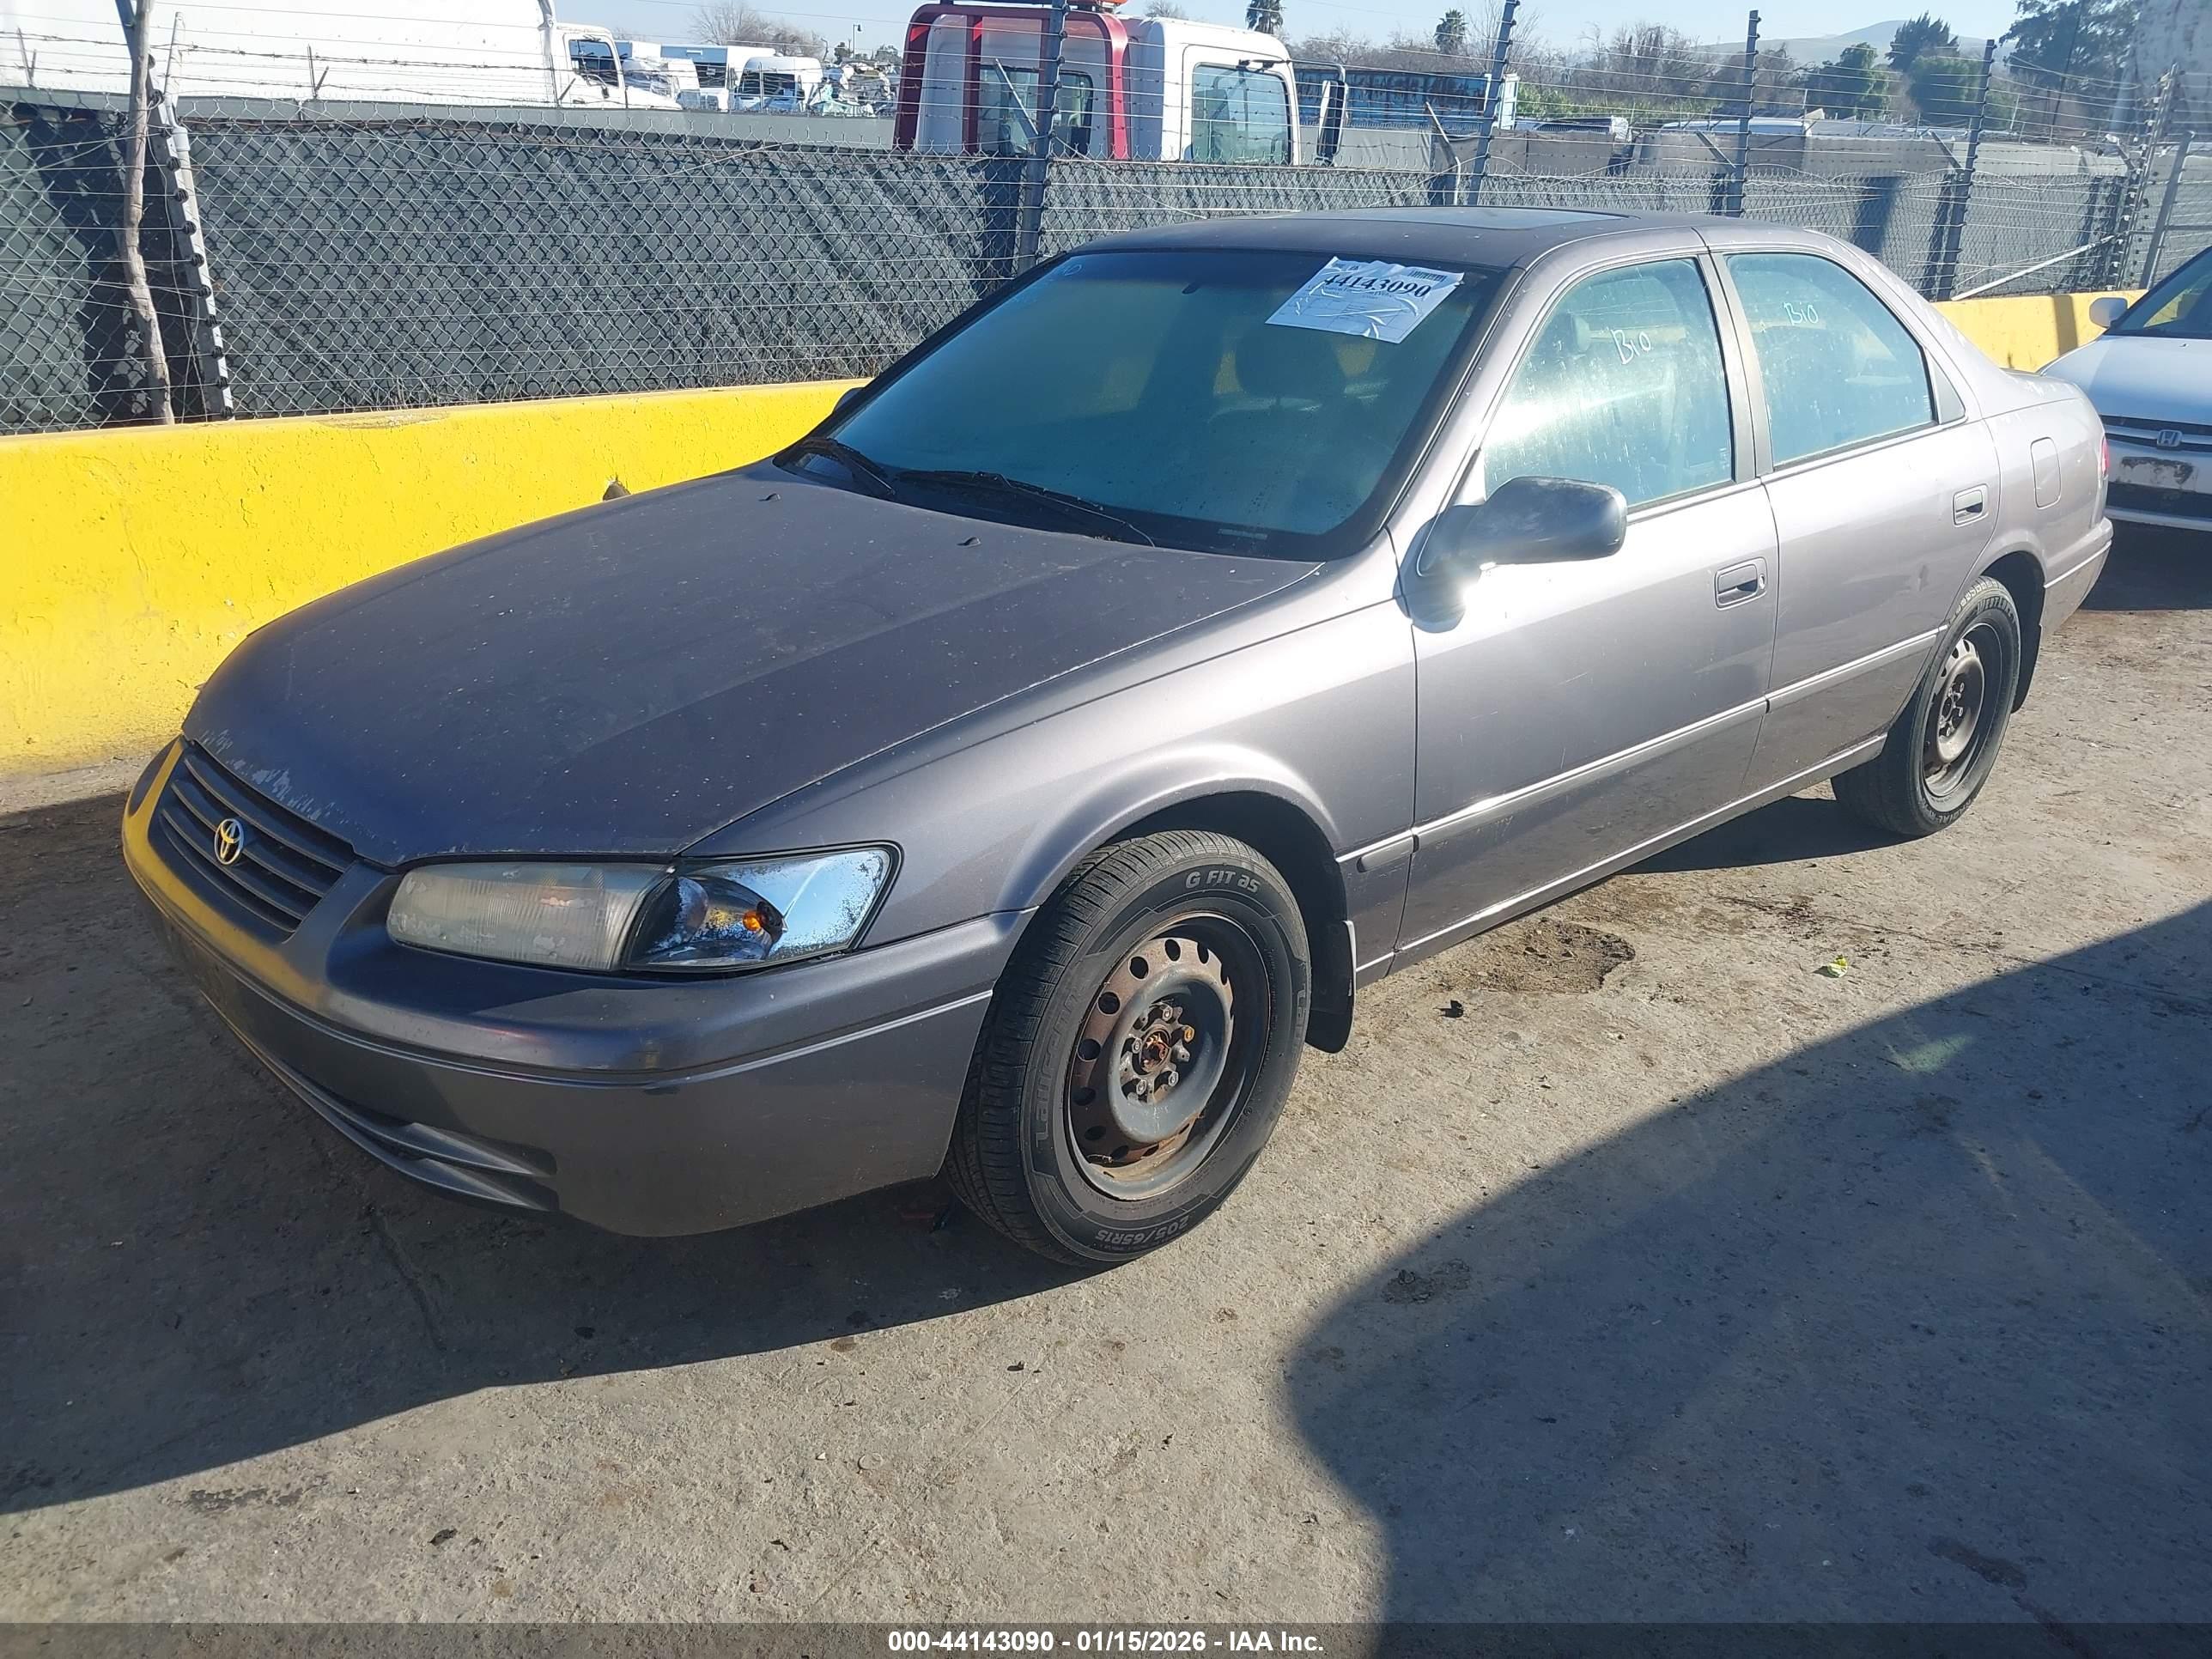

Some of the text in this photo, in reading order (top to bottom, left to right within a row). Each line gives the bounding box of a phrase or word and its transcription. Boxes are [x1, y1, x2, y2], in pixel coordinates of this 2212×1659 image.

[1324, 274, 1432, 298] 44143090
[1185, 871, 1201, 889] G
[1206, 870, 1236, 886] FIT
[1095, 1215, 1190, 1245] 205/65R15
